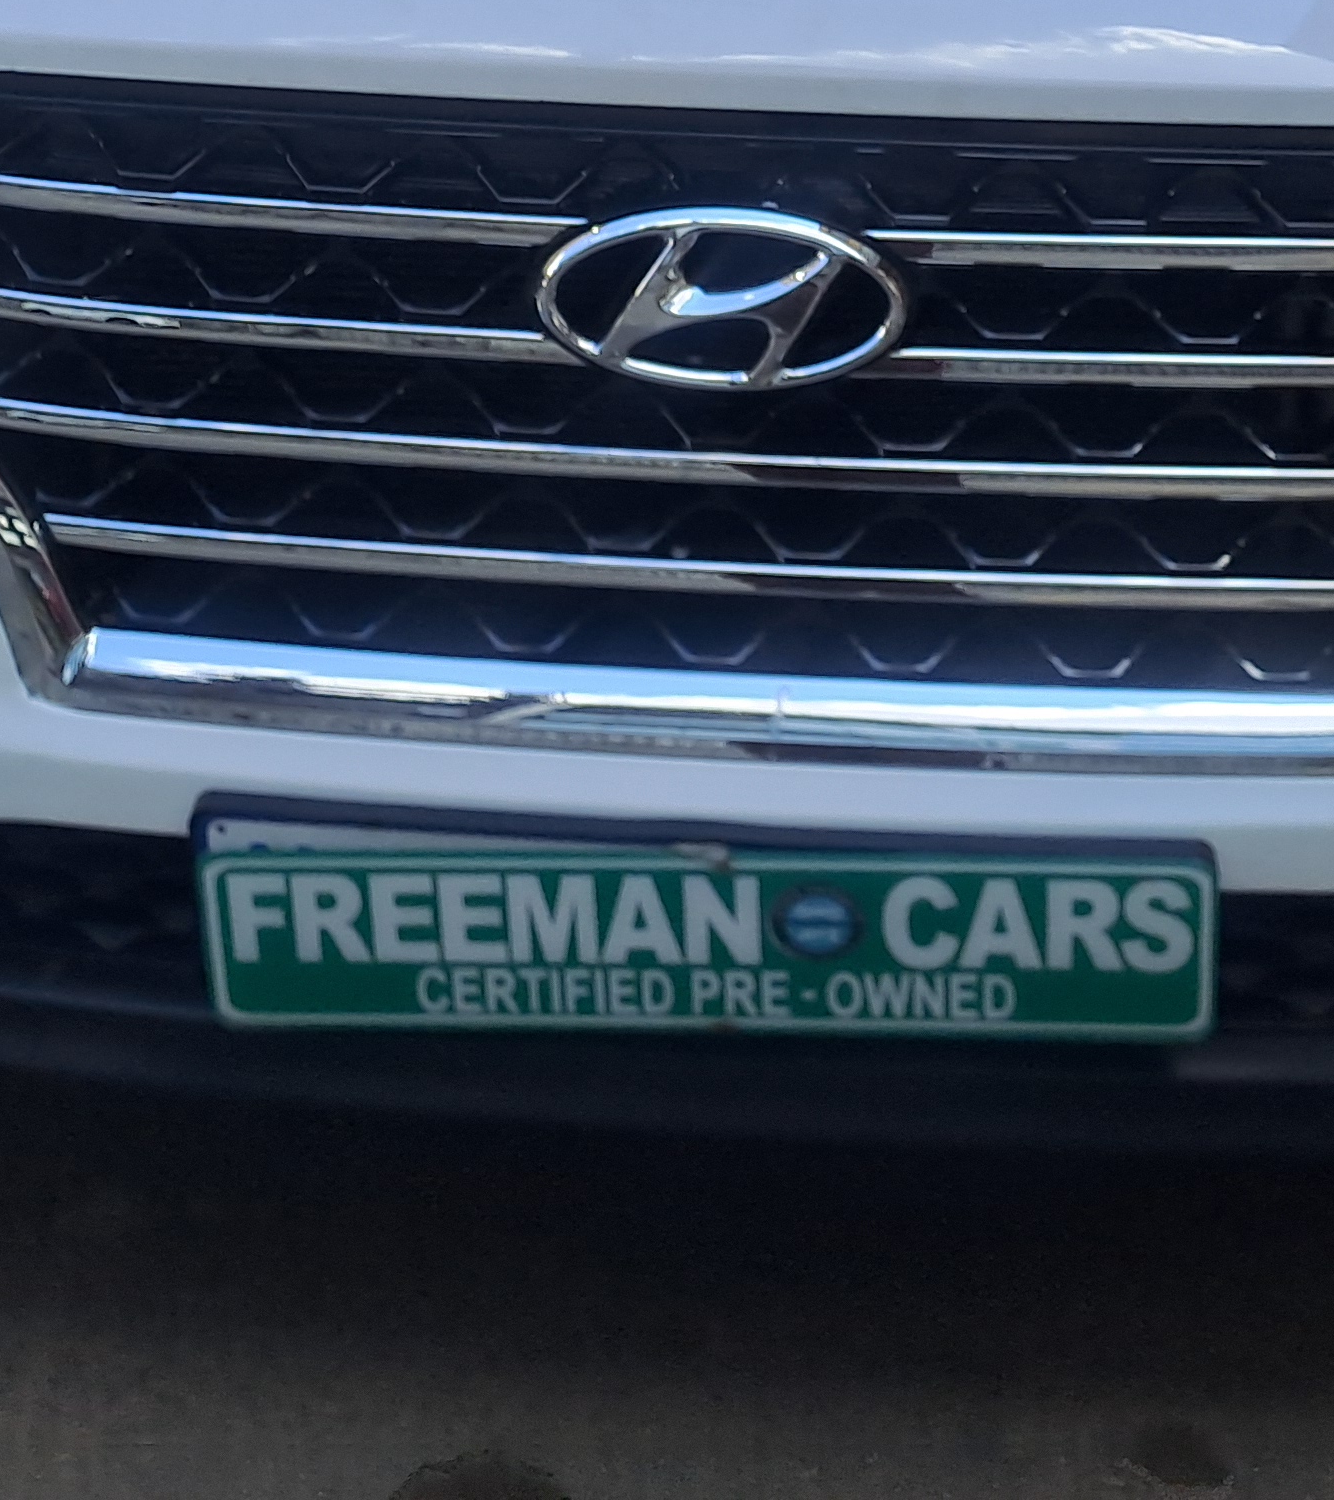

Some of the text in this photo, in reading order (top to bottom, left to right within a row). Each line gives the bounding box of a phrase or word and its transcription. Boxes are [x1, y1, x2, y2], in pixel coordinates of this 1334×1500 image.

[223, 870, 764, 967] FREEMAN
[880, 874, 1195, 973] CARS
[414, 966, 676, 1018] CERTIFIED
